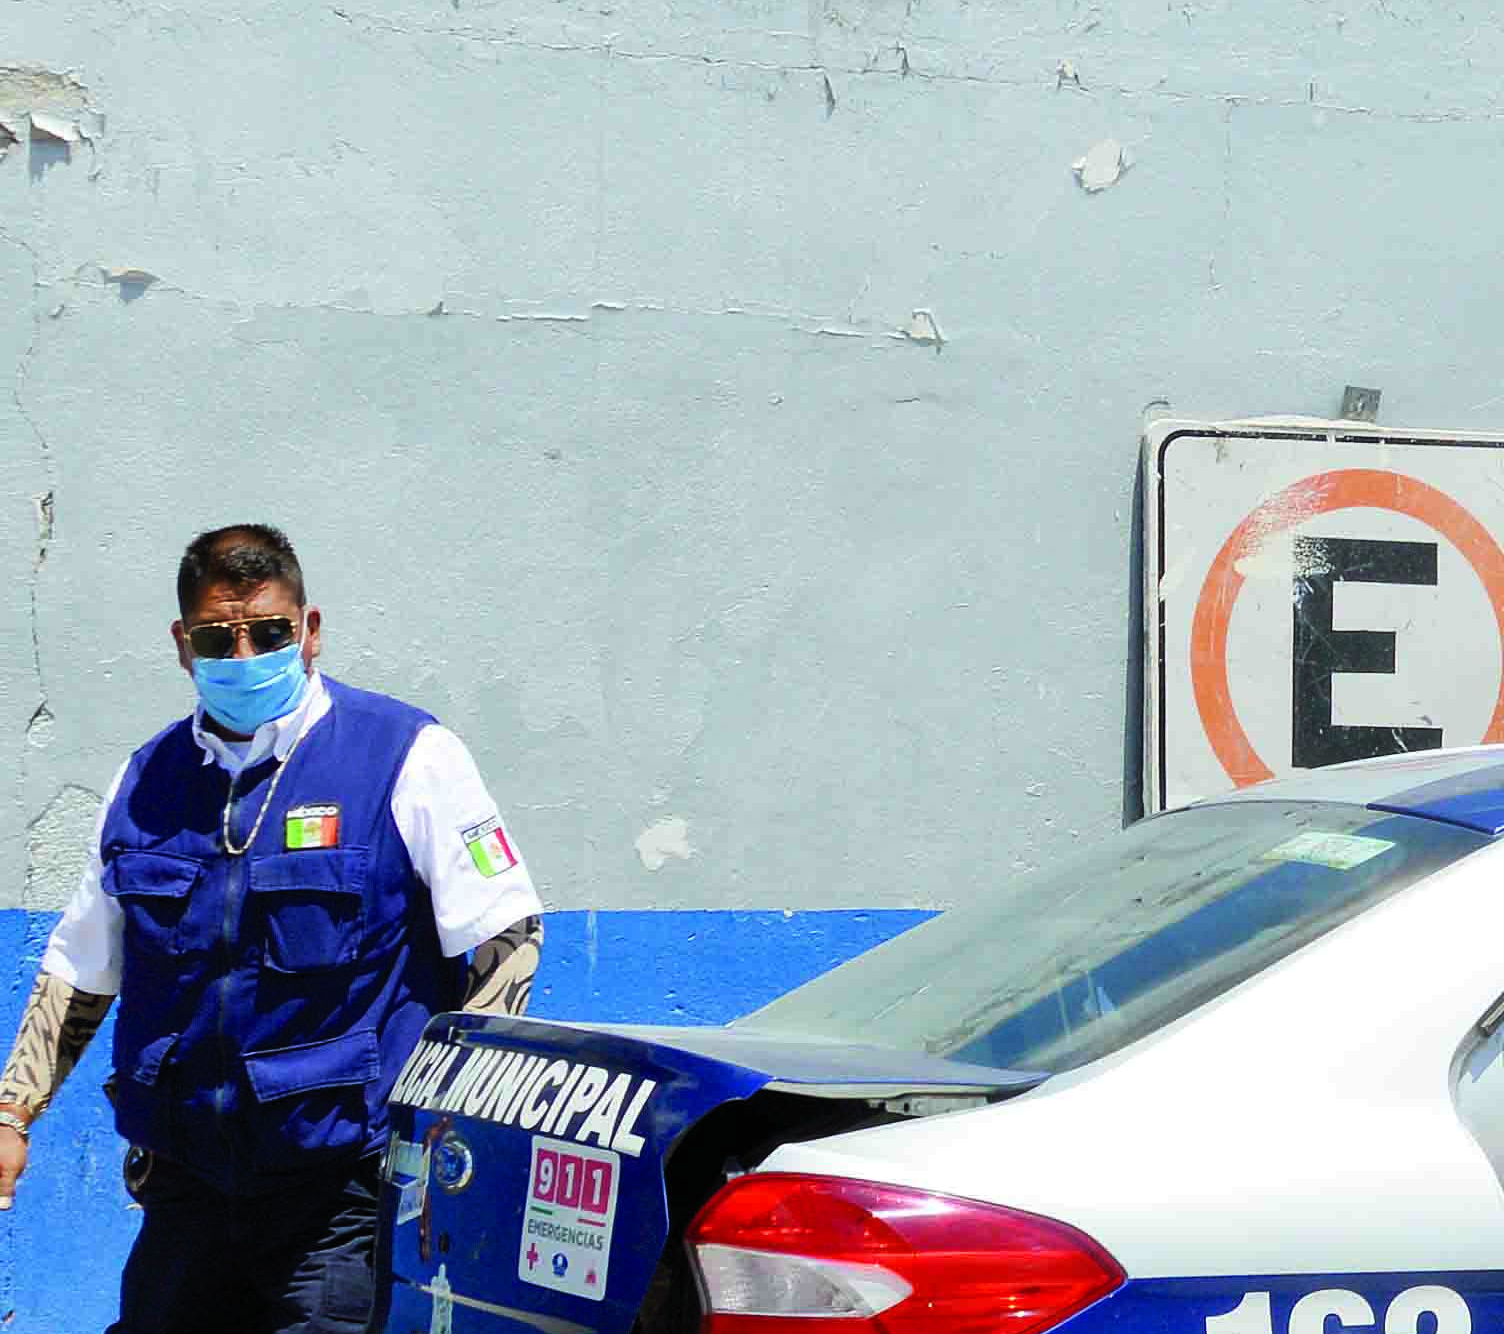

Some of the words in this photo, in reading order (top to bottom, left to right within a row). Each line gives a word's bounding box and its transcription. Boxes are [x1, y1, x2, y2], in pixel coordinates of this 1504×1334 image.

[1292, 537, 1442, 768] E
[440, 1046, 656, 1157] MUNICIPAL
[538, 1158, 605, 1207] 911
[527, 1218, 604, 1251] EMERGENCIAS
